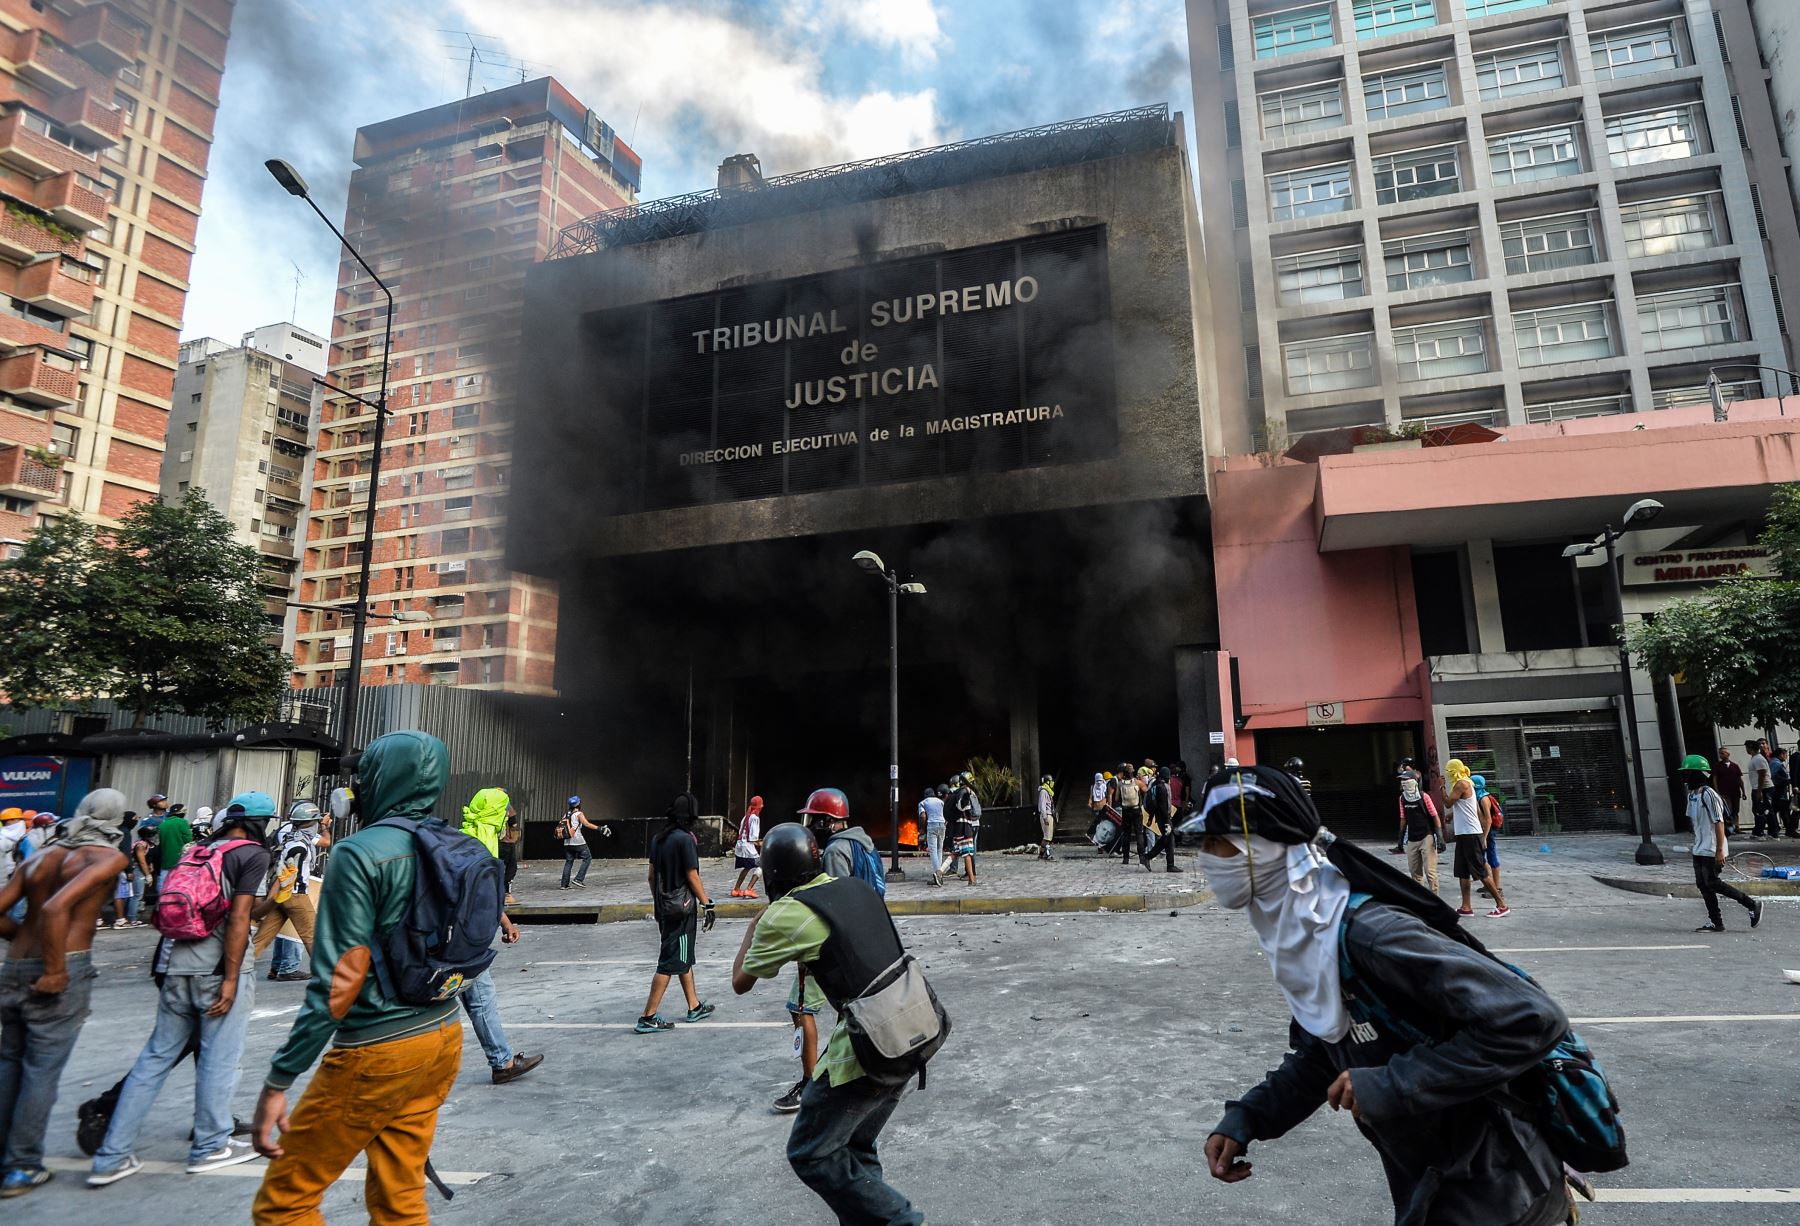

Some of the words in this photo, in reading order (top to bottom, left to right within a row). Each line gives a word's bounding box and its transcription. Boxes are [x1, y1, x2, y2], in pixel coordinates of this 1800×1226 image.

[692, 310, 847, 354] TRIBUNAL
[871, 275, 1039, 327] SUPREMO
[840, 339, 879, 365] de
[785, 363, 939, 409] JUSTICIA
[679, 444, 762, 467] DIRECCION
[772, 431, 858, 455] EJECUTIVA
[869, 428, 889, 441] de
[900, 424, 915, 438] la
[926, 404, 1064, 435] MAGISTRATURA
[1635, 554, 1683, 566] CENTRO
[1688, 549, 1770, 561] PROFESIONAL
[2, 771, 52, 781] VULKAN
